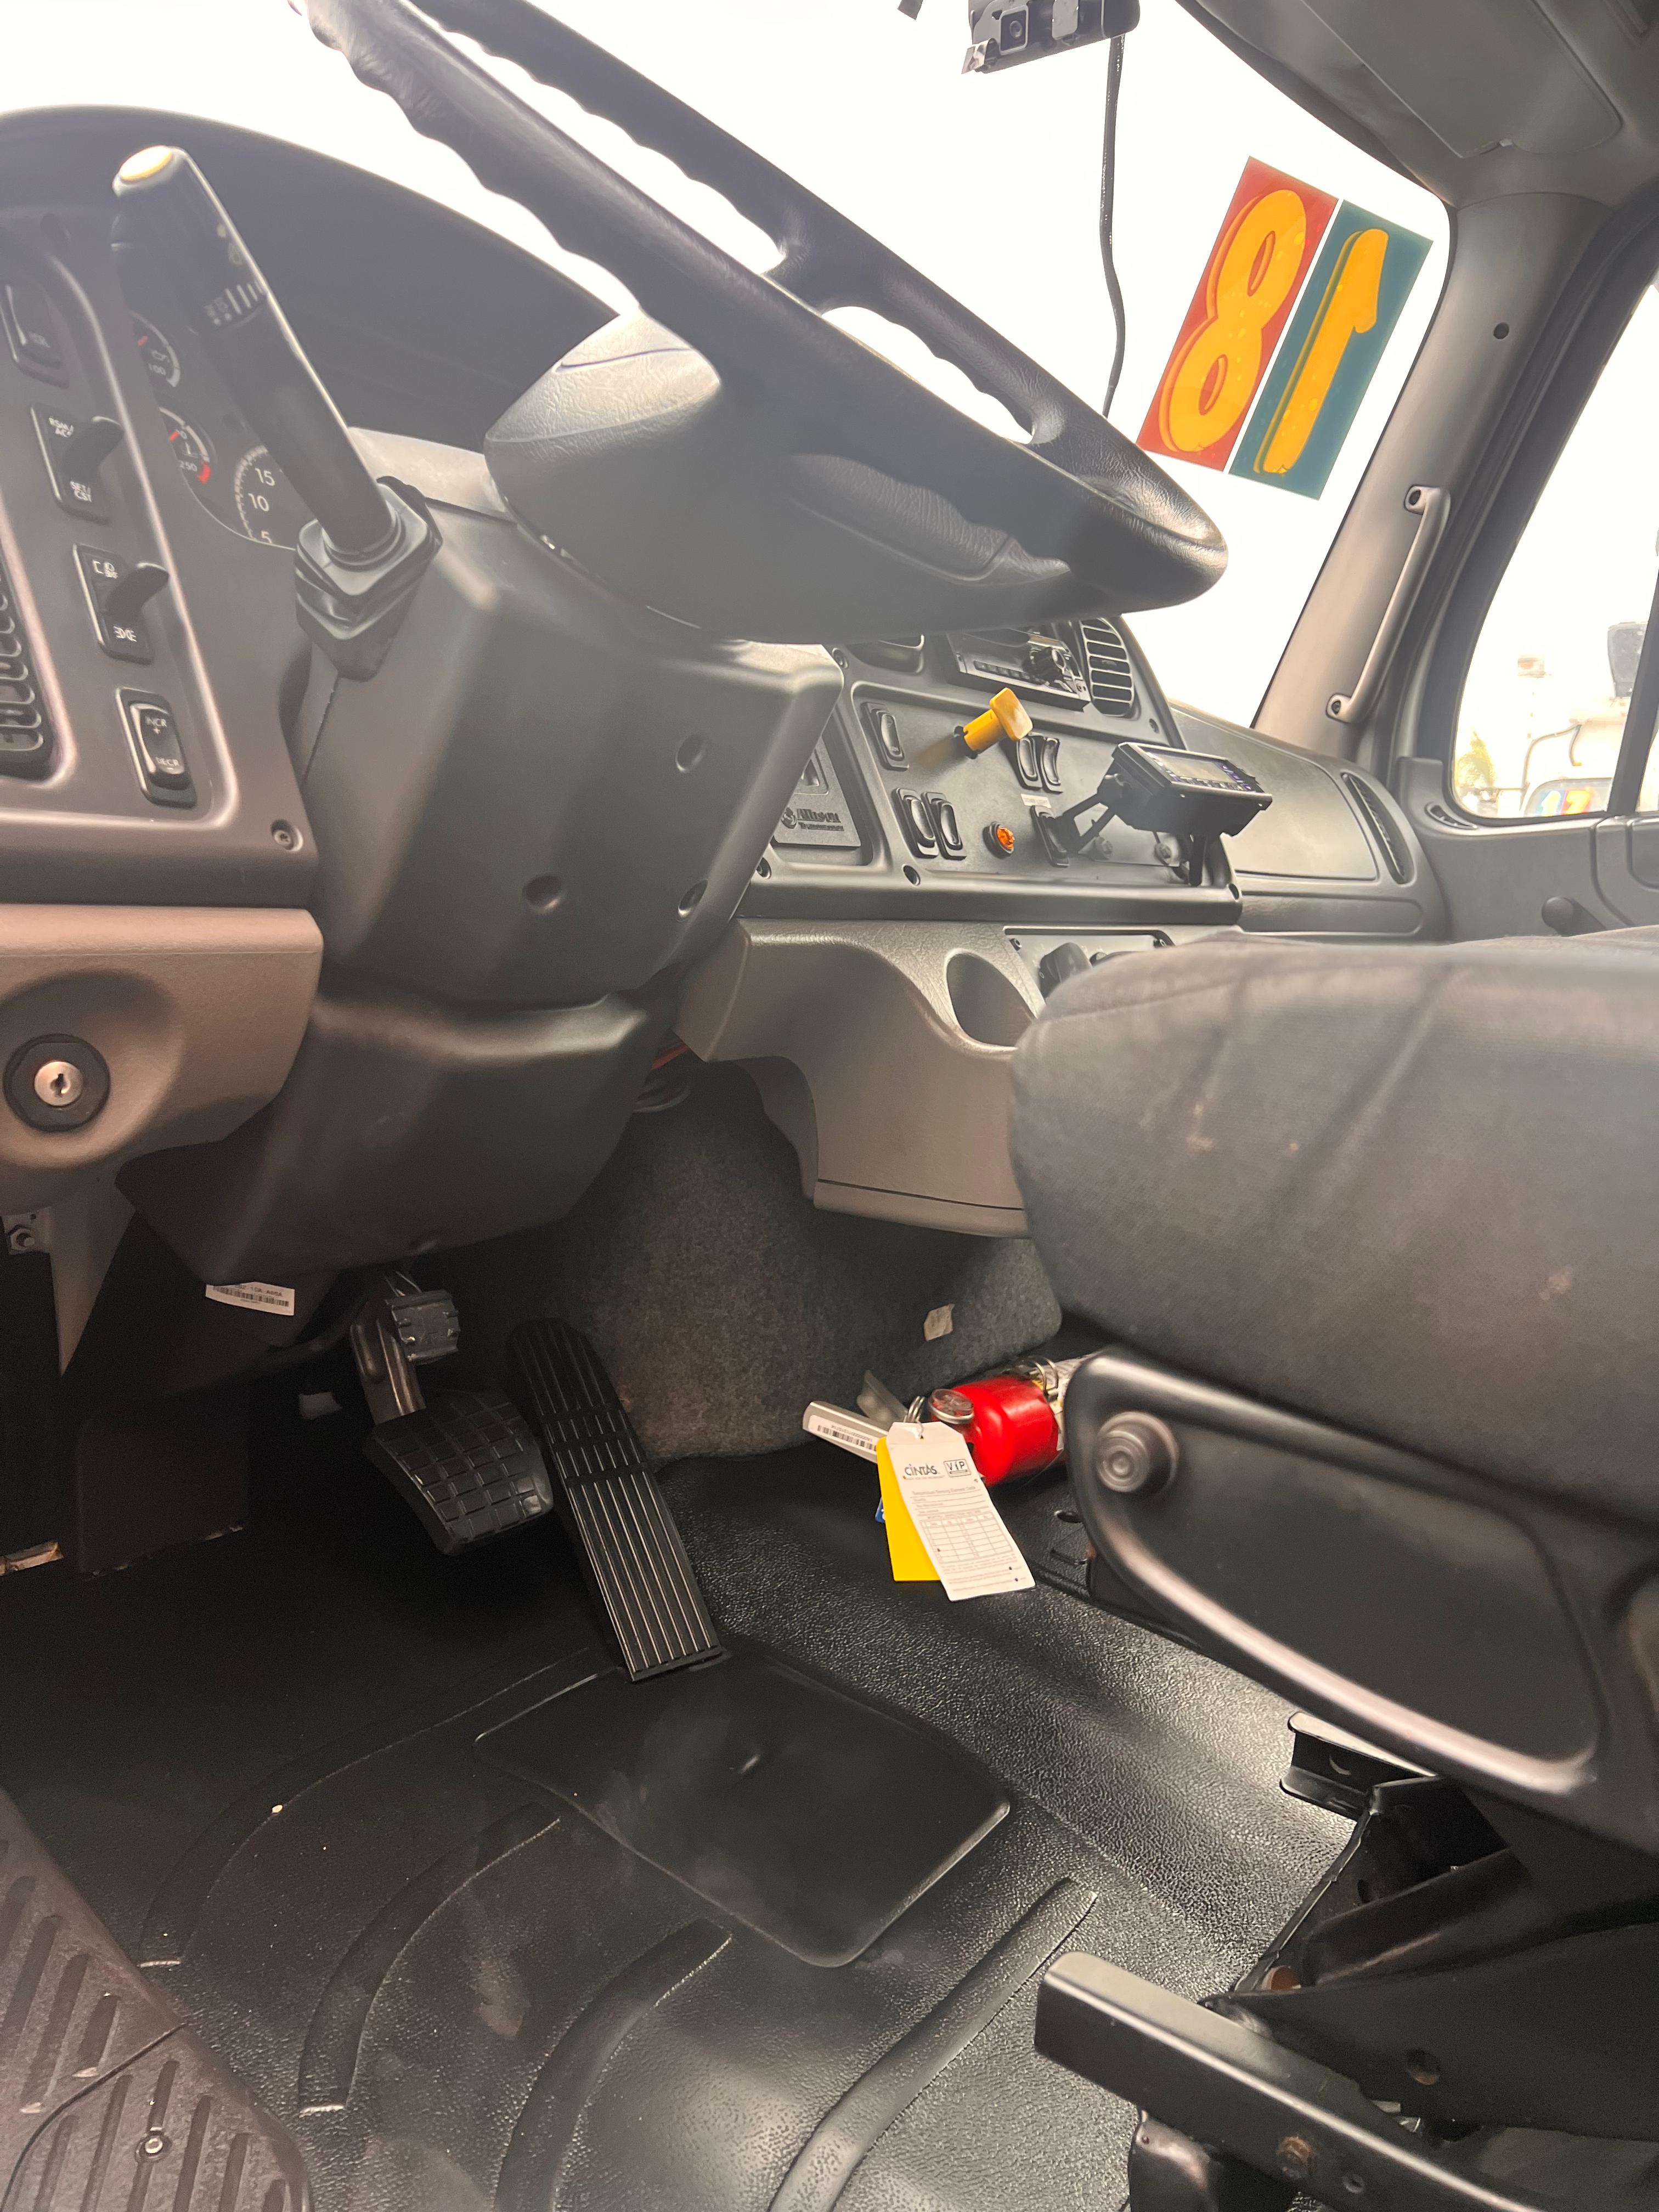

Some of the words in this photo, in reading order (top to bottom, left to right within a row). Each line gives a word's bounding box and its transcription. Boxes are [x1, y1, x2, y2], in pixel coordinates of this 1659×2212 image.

[255, 468, 275, 486] 15
[248, 493, 269, 511] 10
[261, 531, 273, 544] 5
[145, 716, 167, 727] INCR
[155, 757, 180, 766] DECR
[946, 1461, 965, 1471] VIP
